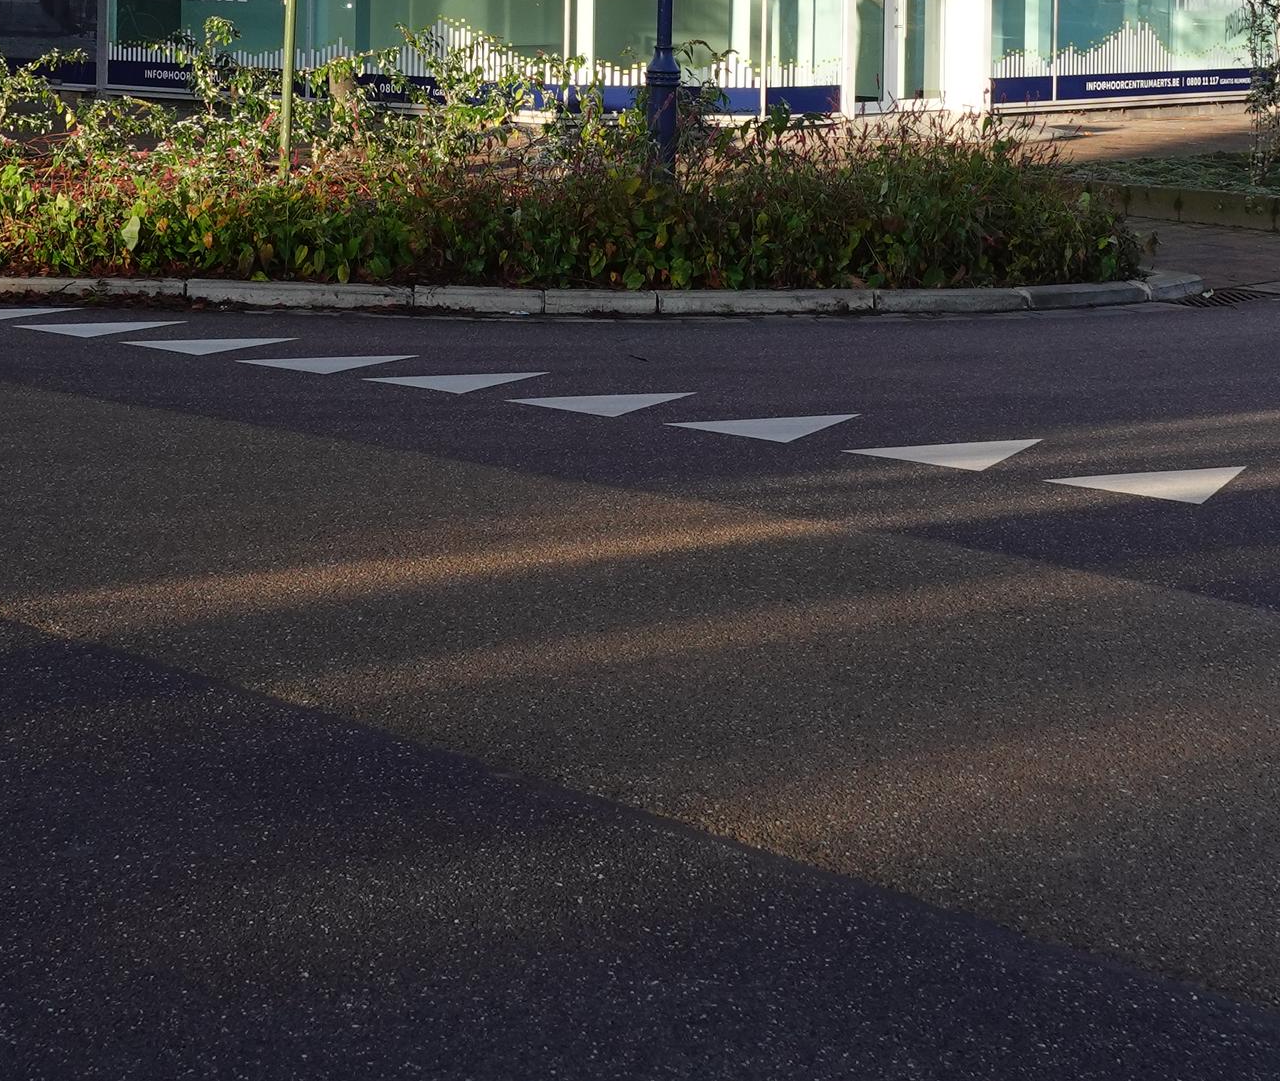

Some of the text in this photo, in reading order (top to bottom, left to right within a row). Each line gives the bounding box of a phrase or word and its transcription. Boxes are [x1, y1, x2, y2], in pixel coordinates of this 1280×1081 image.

[1086, 77, 1180, 91] INFO@HOORCENTRUMAERTS.BE
[1186, 77, 1202, 86] 0800
[1209, 76, 1220, 85] 117
